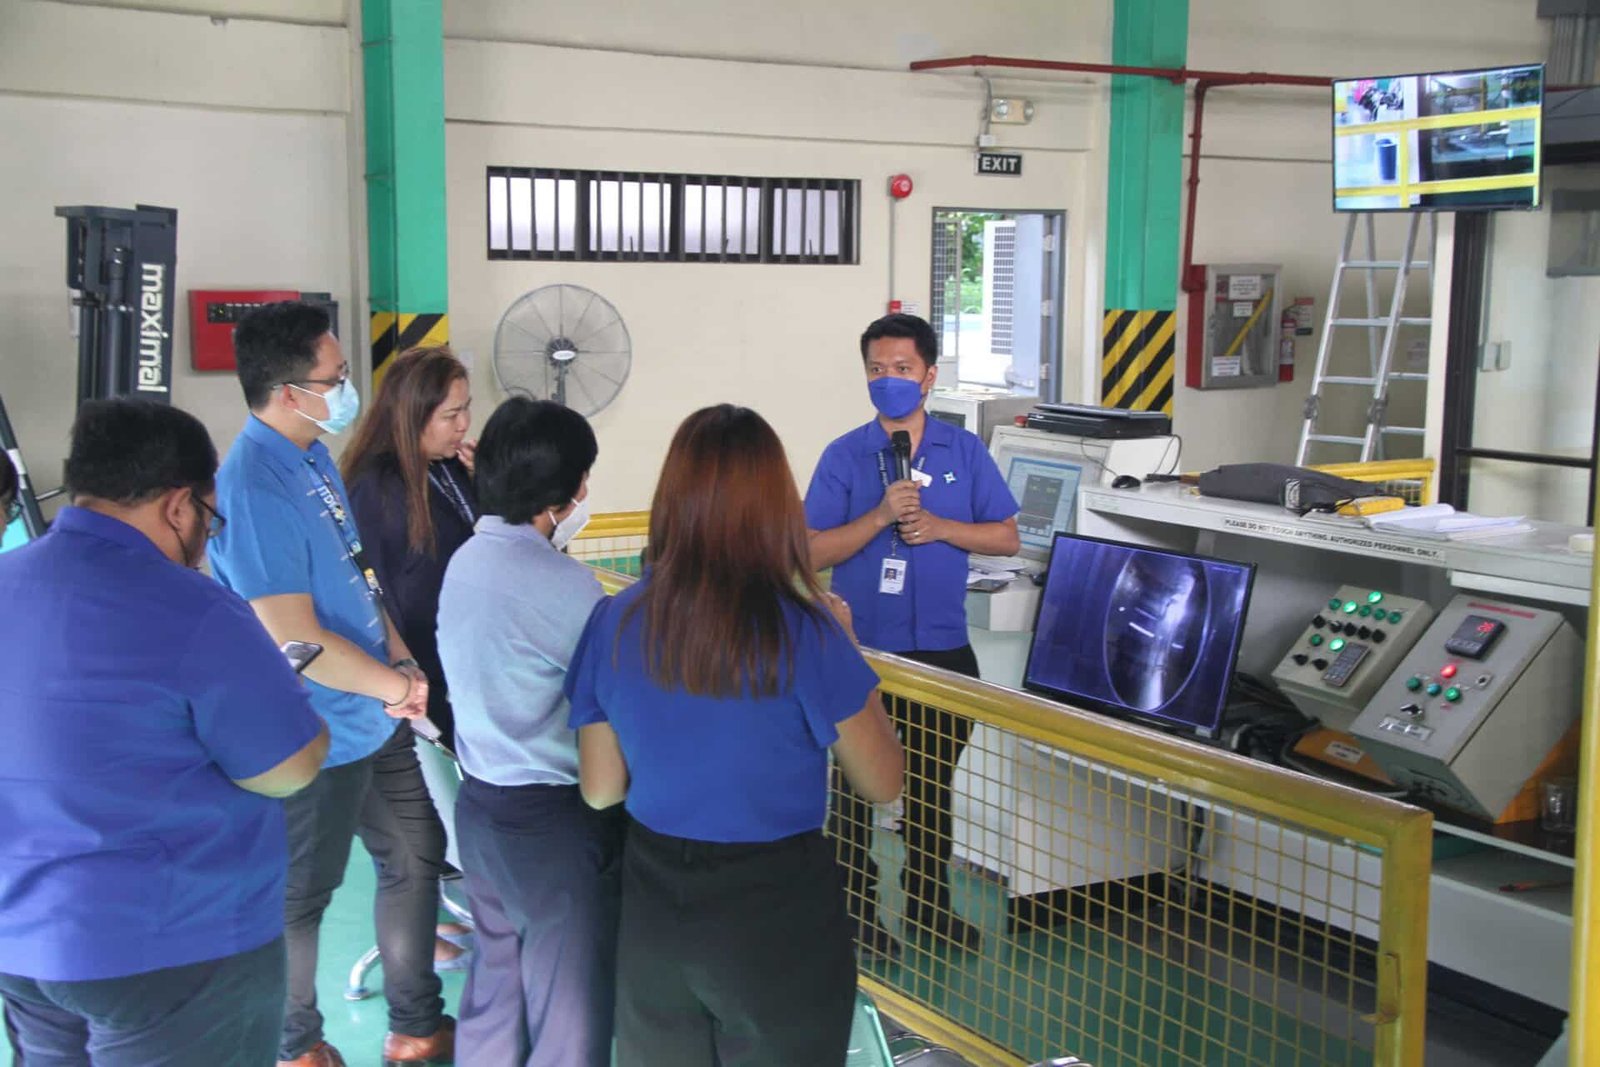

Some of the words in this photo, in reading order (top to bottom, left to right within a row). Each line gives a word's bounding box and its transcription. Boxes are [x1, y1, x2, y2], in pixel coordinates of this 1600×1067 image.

[982, 157, 1018, 172] EXIT
[137, 263, 169, 392] maximal
[1225, 519, 1247, 529] PLEASE
[1272, 526, 1293, 535] TOUCH
[1330, 536, 1373, 548] AUTHORIZED
[1374, 543, 1416, 555] PERSONNEL
